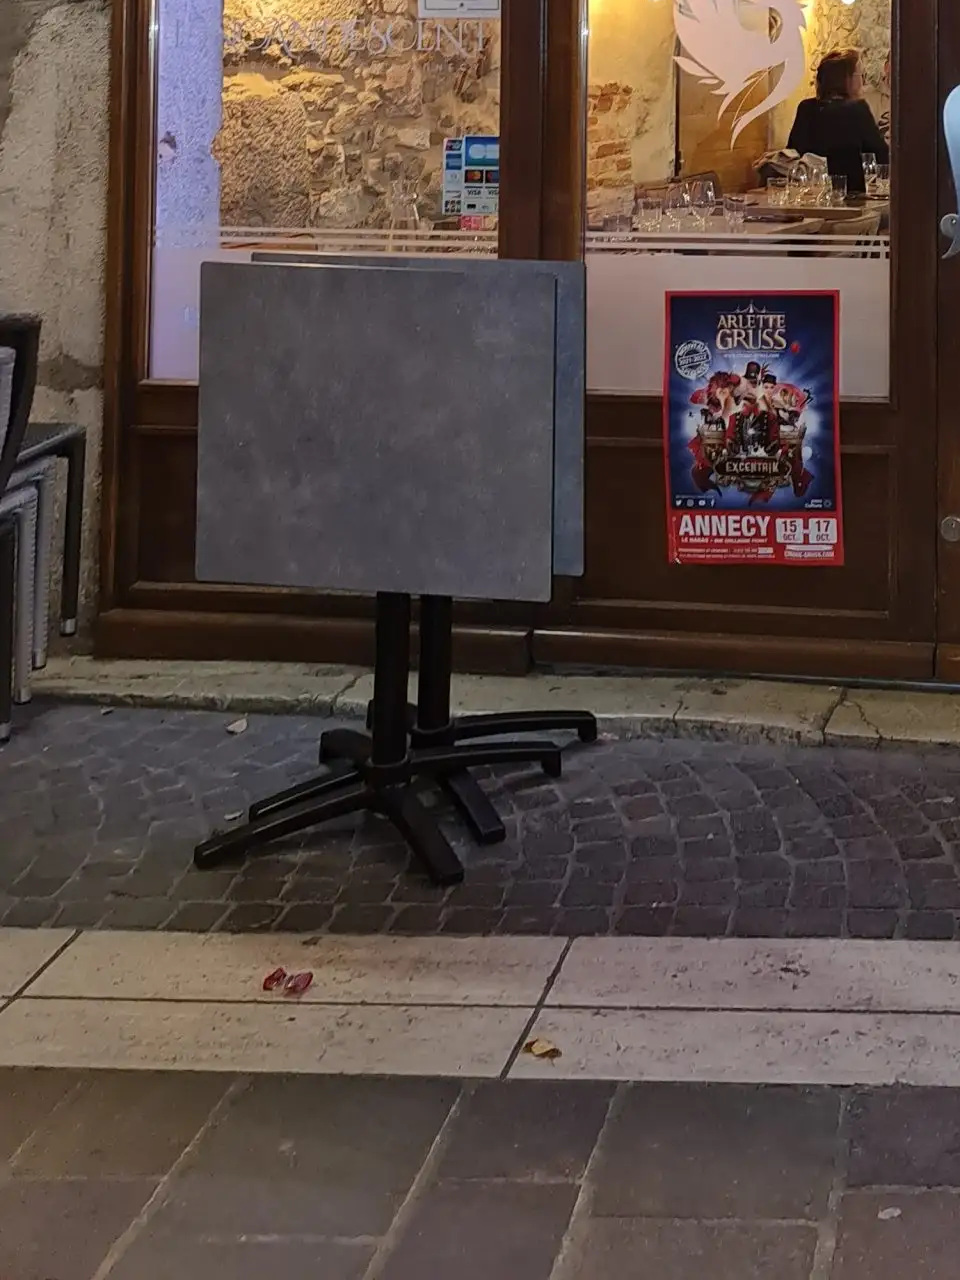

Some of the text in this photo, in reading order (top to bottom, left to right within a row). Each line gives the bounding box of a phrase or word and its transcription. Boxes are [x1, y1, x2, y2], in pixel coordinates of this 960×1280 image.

[488, 189, 499, 197] VIS
[717, 314, 786, 329] ARLETTE
[716, 328, 787, 351] GRUSS
[725, 461, 780, 474] EXCENTRIK
[679, 515, 770, 537] ANNECY
[781, 519, 798, 532] 15
[815, 520, 831, 533] 17
